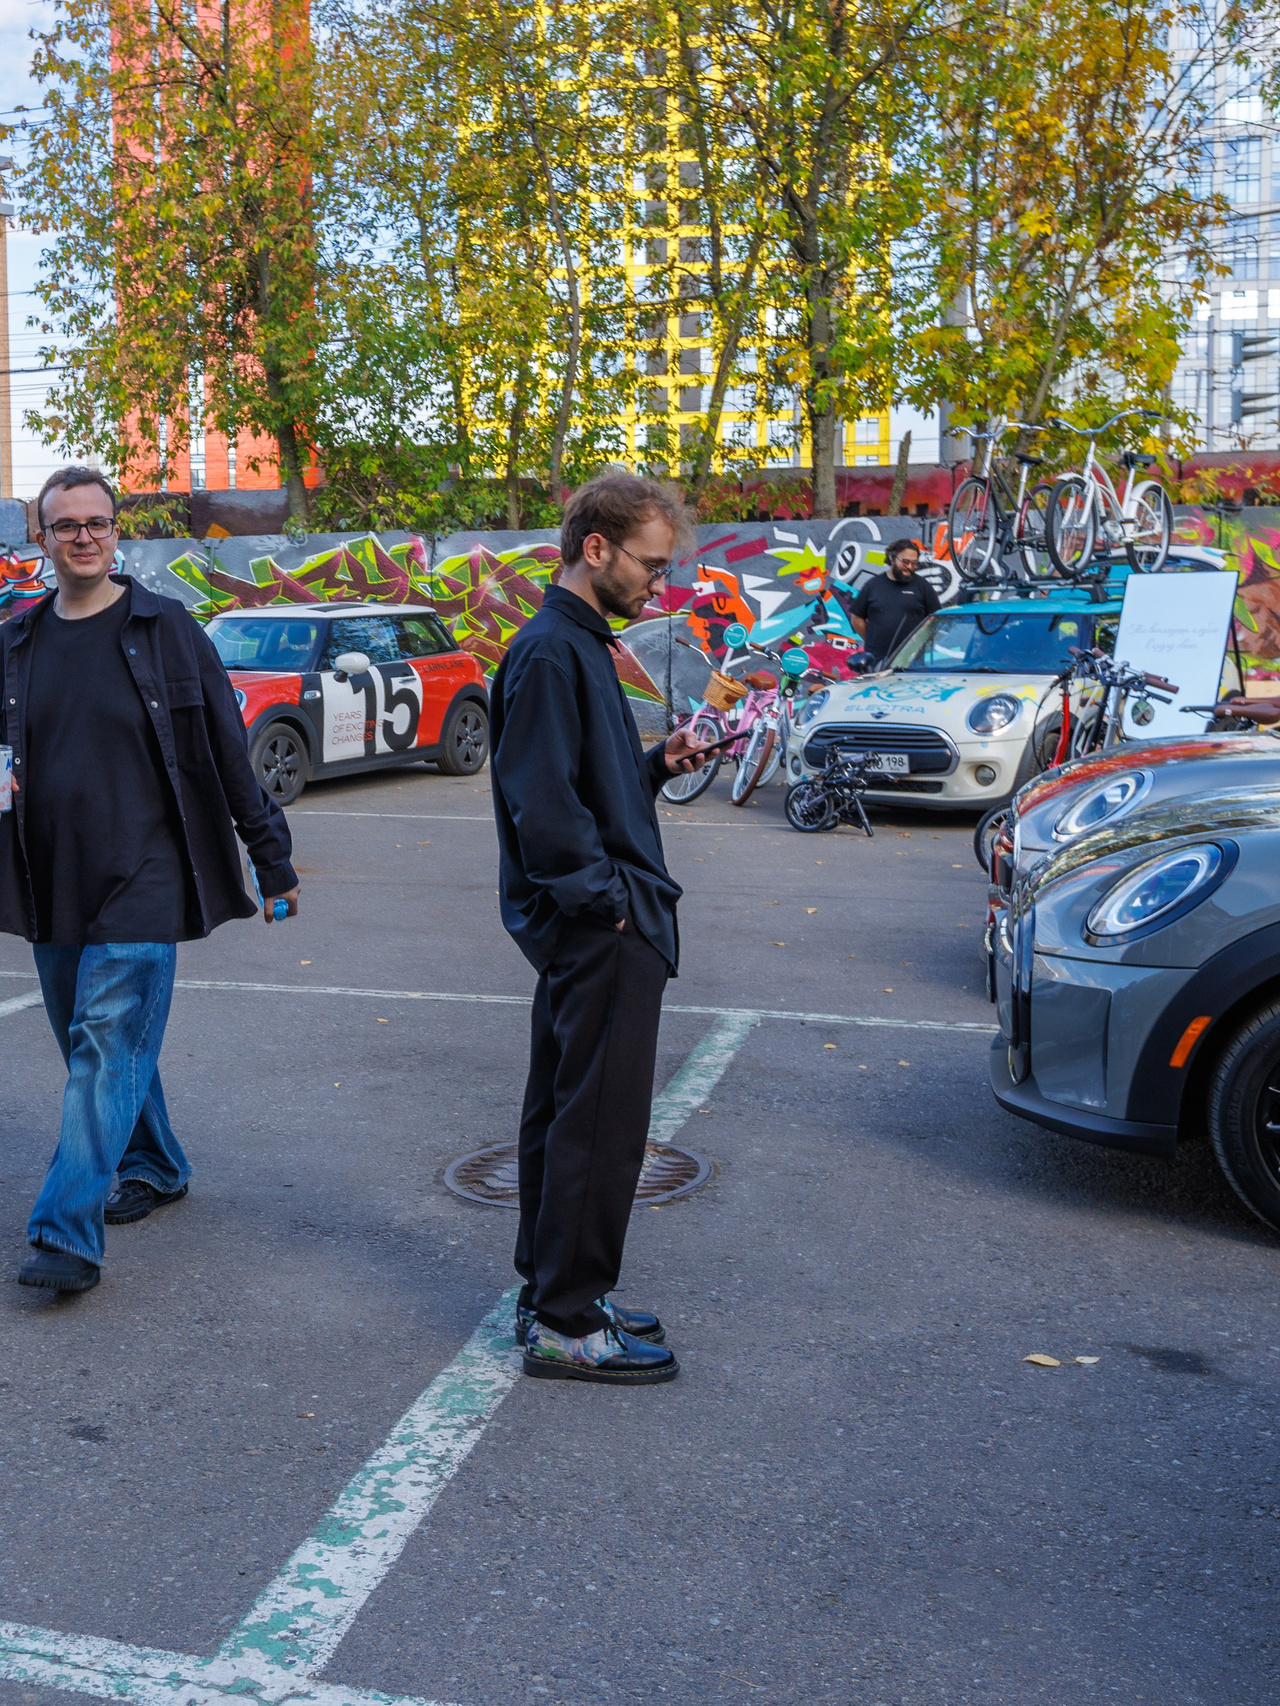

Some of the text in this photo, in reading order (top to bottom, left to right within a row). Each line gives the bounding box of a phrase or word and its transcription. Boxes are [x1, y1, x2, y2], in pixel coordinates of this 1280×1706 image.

[347, 661, 421, 756] 15
[844, 704, 925, 714] ELECTRA
[332, 710, 362, 722] YEARS
[332, 718, 384, 734] OF EXCITING
[331, 731, 374, 746] CHANGES
[885, 756, 904, 767] 198
